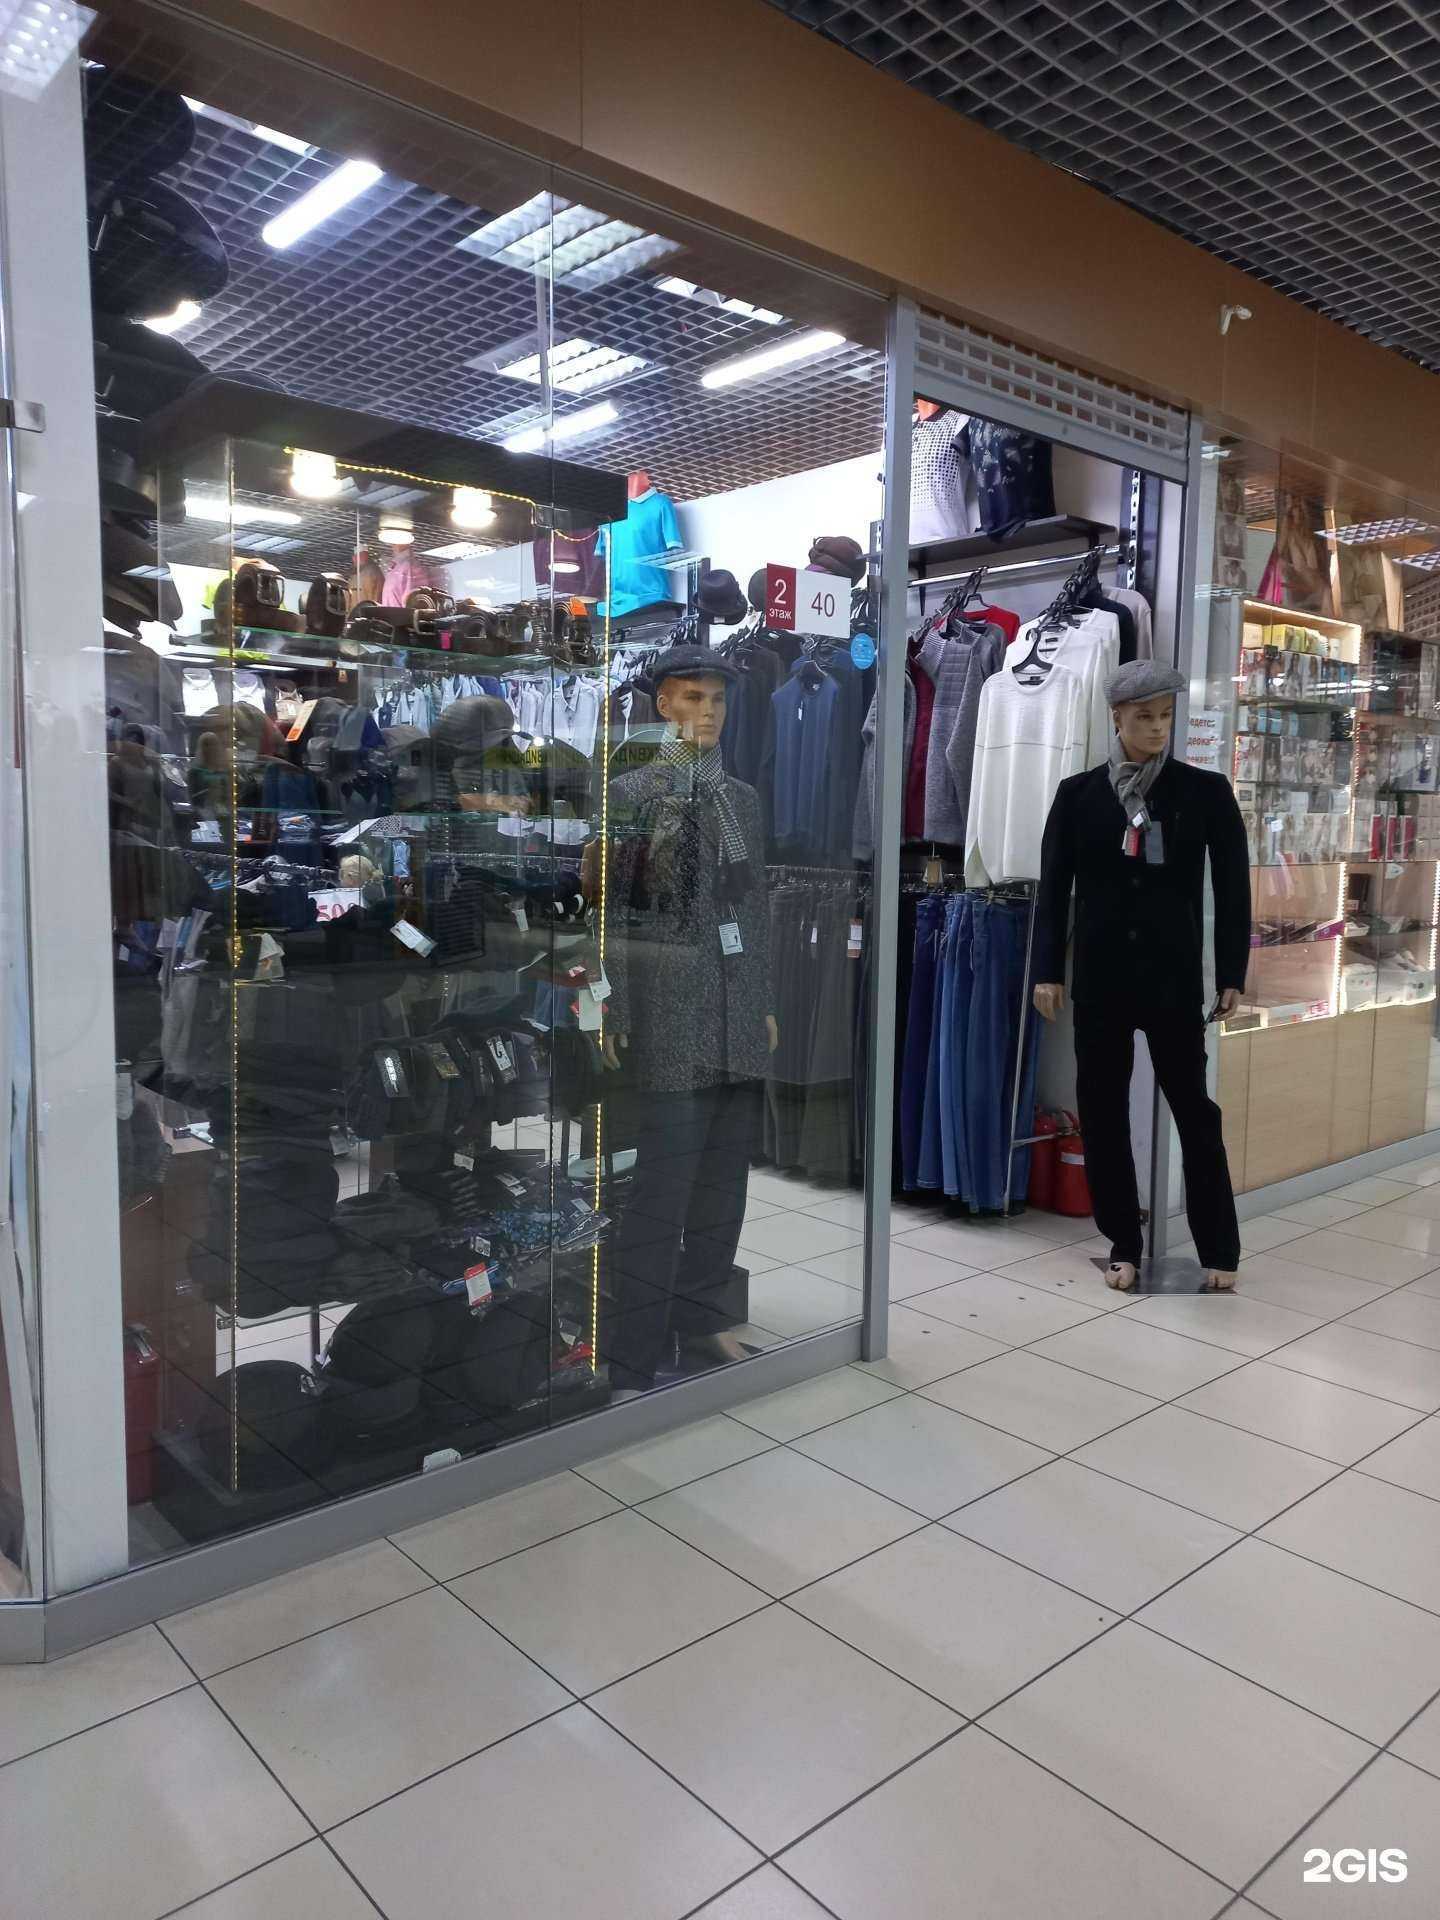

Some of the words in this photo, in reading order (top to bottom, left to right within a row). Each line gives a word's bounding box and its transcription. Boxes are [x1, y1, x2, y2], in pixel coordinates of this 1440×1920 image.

[774, 579, 787, 604] 2
[769, 607, 792, 620] этаж
[811, 591, 835, 618] 40
